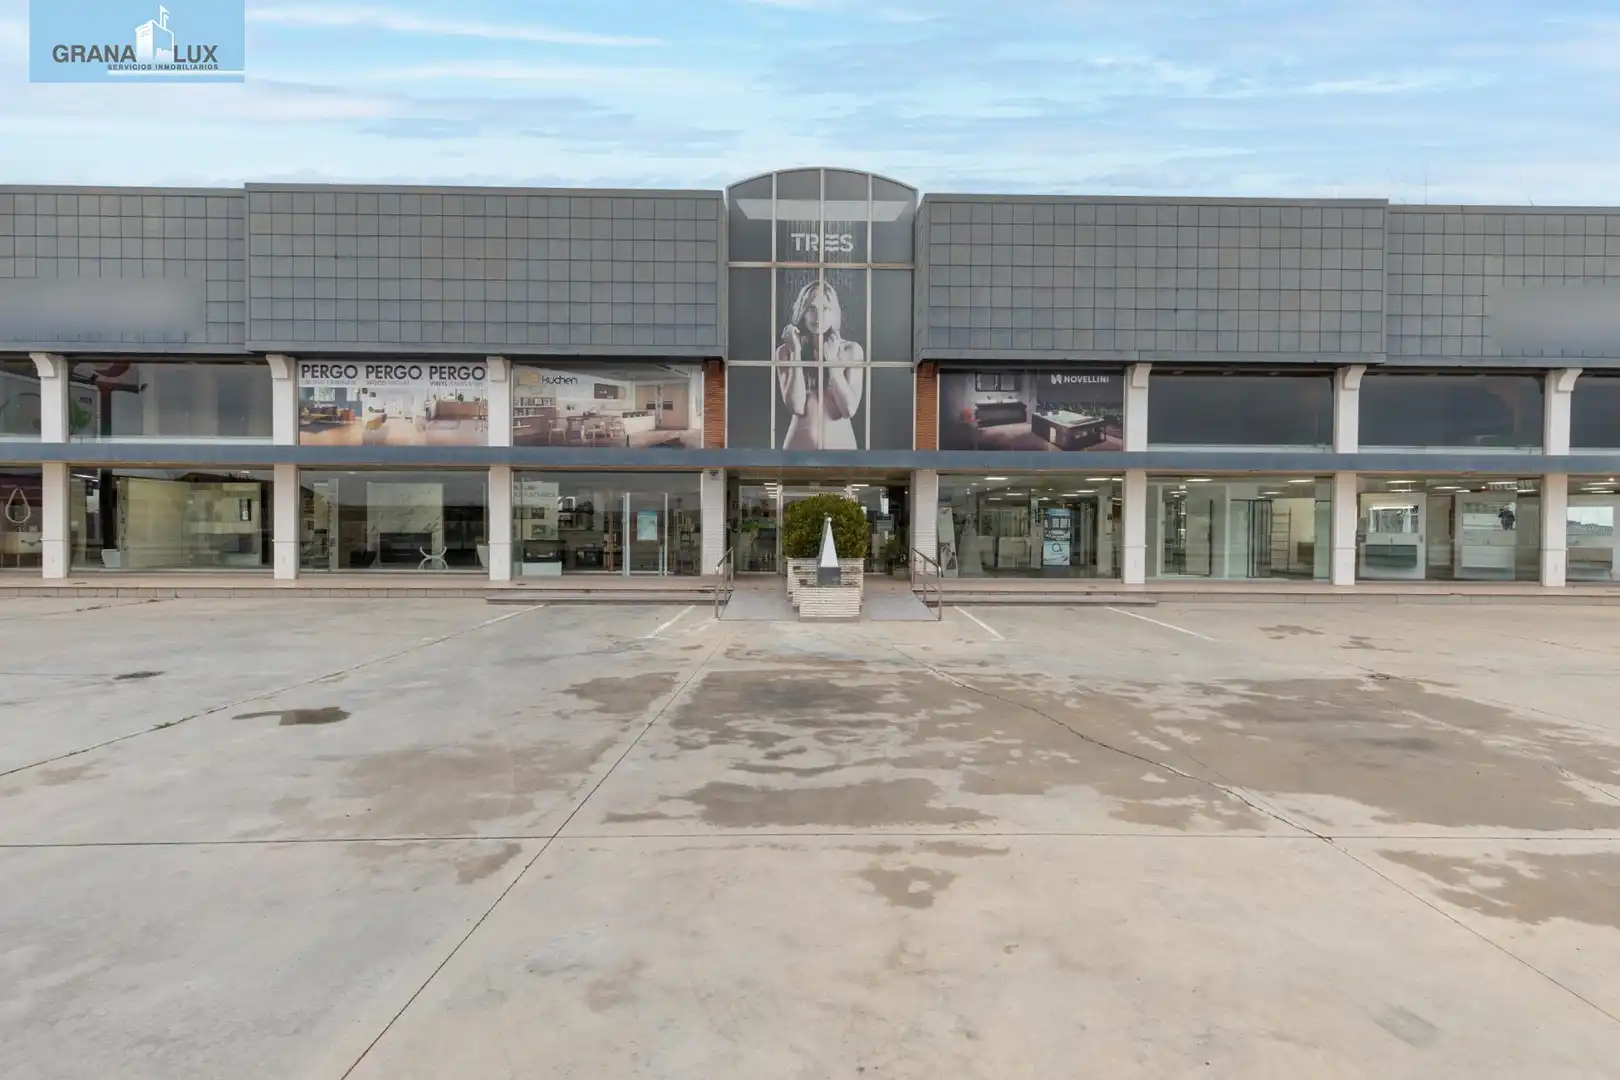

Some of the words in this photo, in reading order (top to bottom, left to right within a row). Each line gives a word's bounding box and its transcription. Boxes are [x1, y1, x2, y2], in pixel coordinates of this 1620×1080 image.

[790, 232, 854, 252] TRES
[301, 364, 358, 379] PERGO
[365, 365, 422, 380] PERGO
[429, 366, 486, 381] PERGO
[1064, 374, 1109, 384] NOVELLINI
